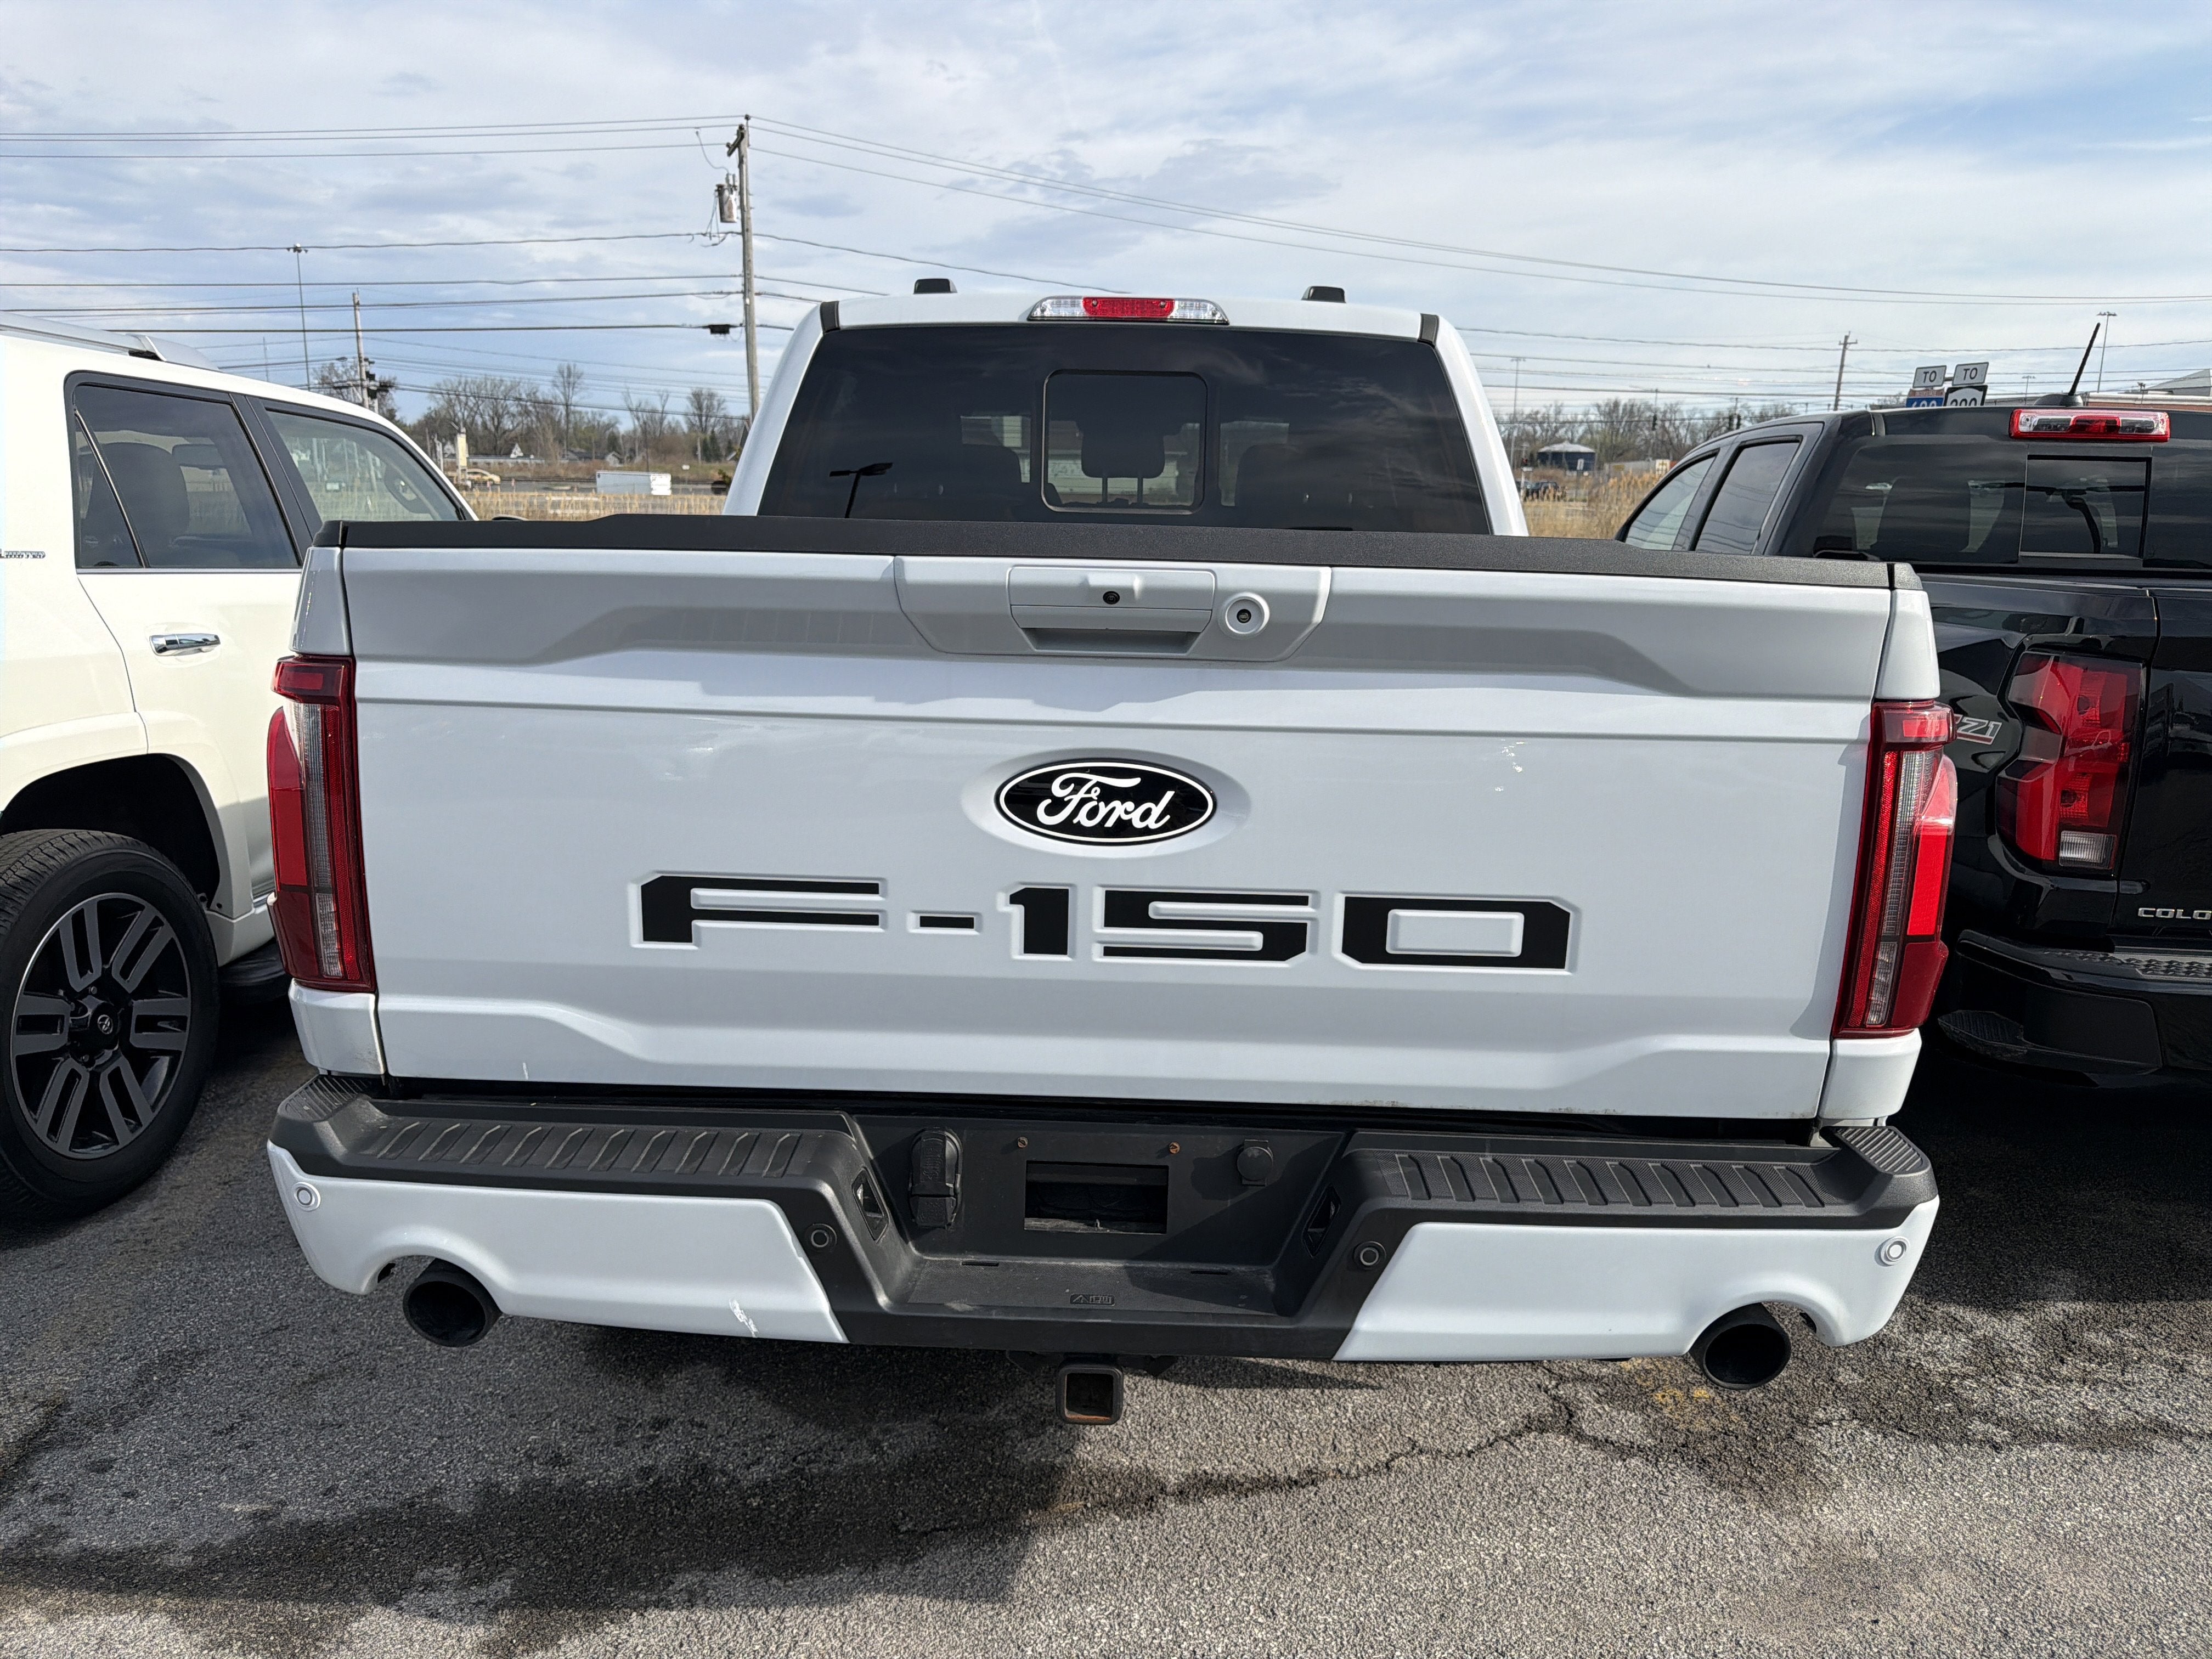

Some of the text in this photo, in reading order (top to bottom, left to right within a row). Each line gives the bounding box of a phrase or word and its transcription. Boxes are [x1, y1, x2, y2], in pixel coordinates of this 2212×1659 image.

[1923, 370, 1937, 383] TO
[1963, 367, 1978, 381] TO
[1036, 772, 1174, 830] Ford
[2137, 907, 2212, 920] COLO
[636, 873, 1573, 971] F-150
